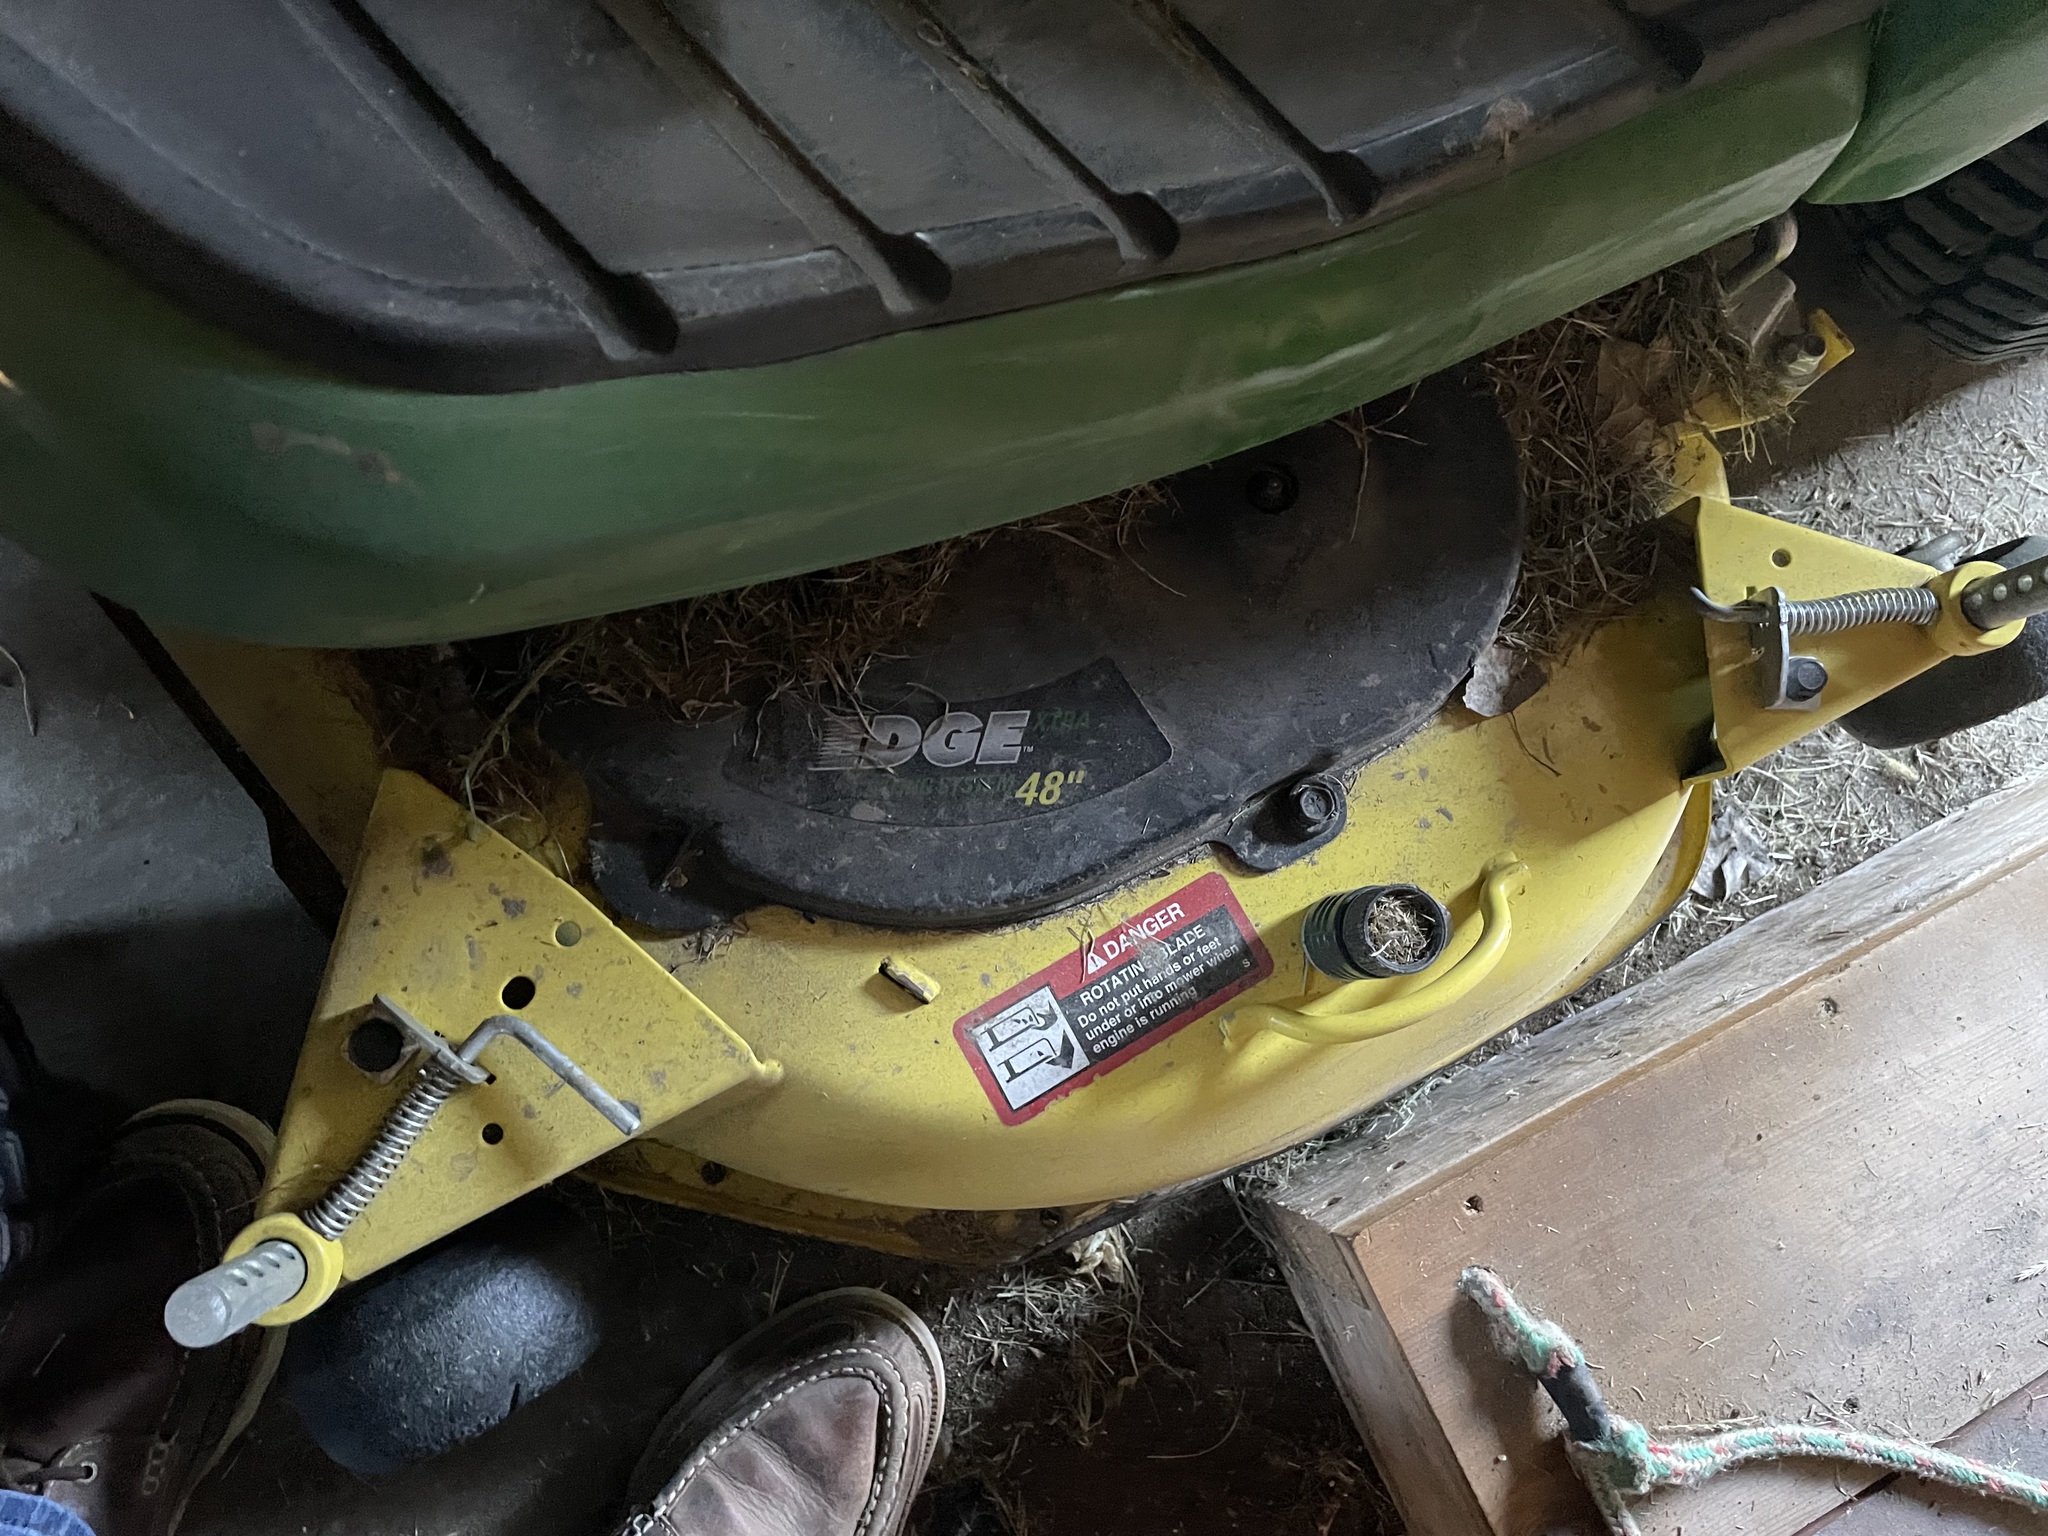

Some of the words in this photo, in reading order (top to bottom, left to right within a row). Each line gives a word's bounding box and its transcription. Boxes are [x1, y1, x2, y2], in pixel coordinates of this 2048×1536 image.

[807, 709, 1031, 772] EDGE
[1015, 771, 1086, 806] 48"
[1103, 902, 1185, 960] DANGER
[1077, 1009, 1103, 1028] Do
[1099, 997, 1122, 1017] not
[1121, 983, 1144, 1005] put
[1142, 961, 1181, 989] hands
[1182, 949, 1197, 964] or
[1196, 936, 1222, 955] feet
[1085, 1017, 1123, 1041] under
[1122, 1007, 1140, 1020] or
[1138, 990, 1165, 1010] into
[1164, 962, 1206, 992] mower
[1205, 943, 1240, 968] when
[1092, 1024, 1135, 1053] engine
[1135, 1015, 1148, 1028] is
[1148, 985, 1199, 1020] running
